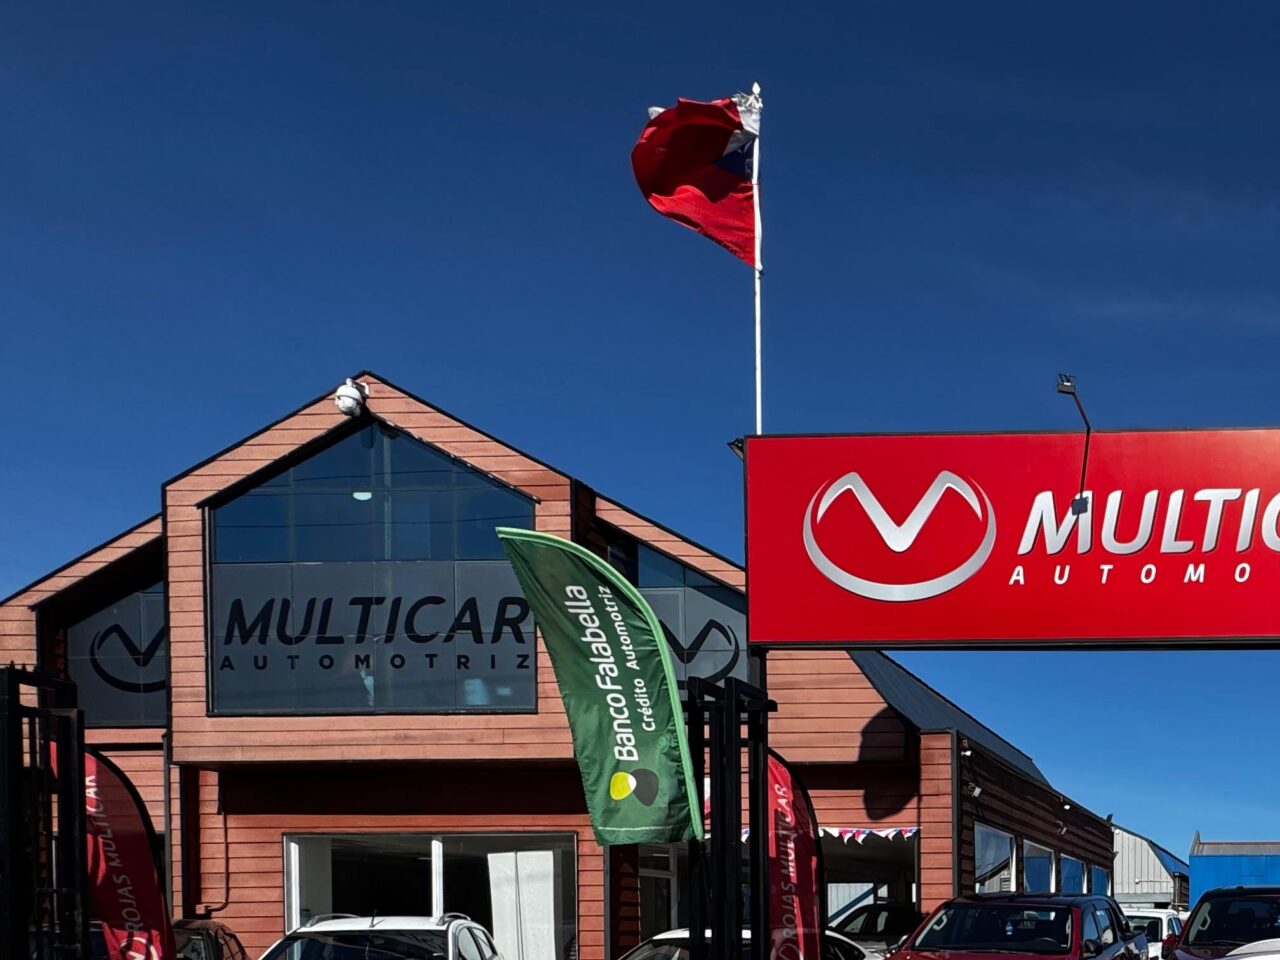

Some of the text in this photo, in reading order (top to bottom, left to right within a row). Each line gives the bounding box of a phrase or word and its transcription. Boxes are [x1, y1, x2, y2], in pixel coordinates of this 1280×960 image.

[223, 596, 530, 646] MULTICAR
[219, 653, 531, 671] AUTOMOTRIZ
[598, 585, 655, 732] Crédito Automotriz
